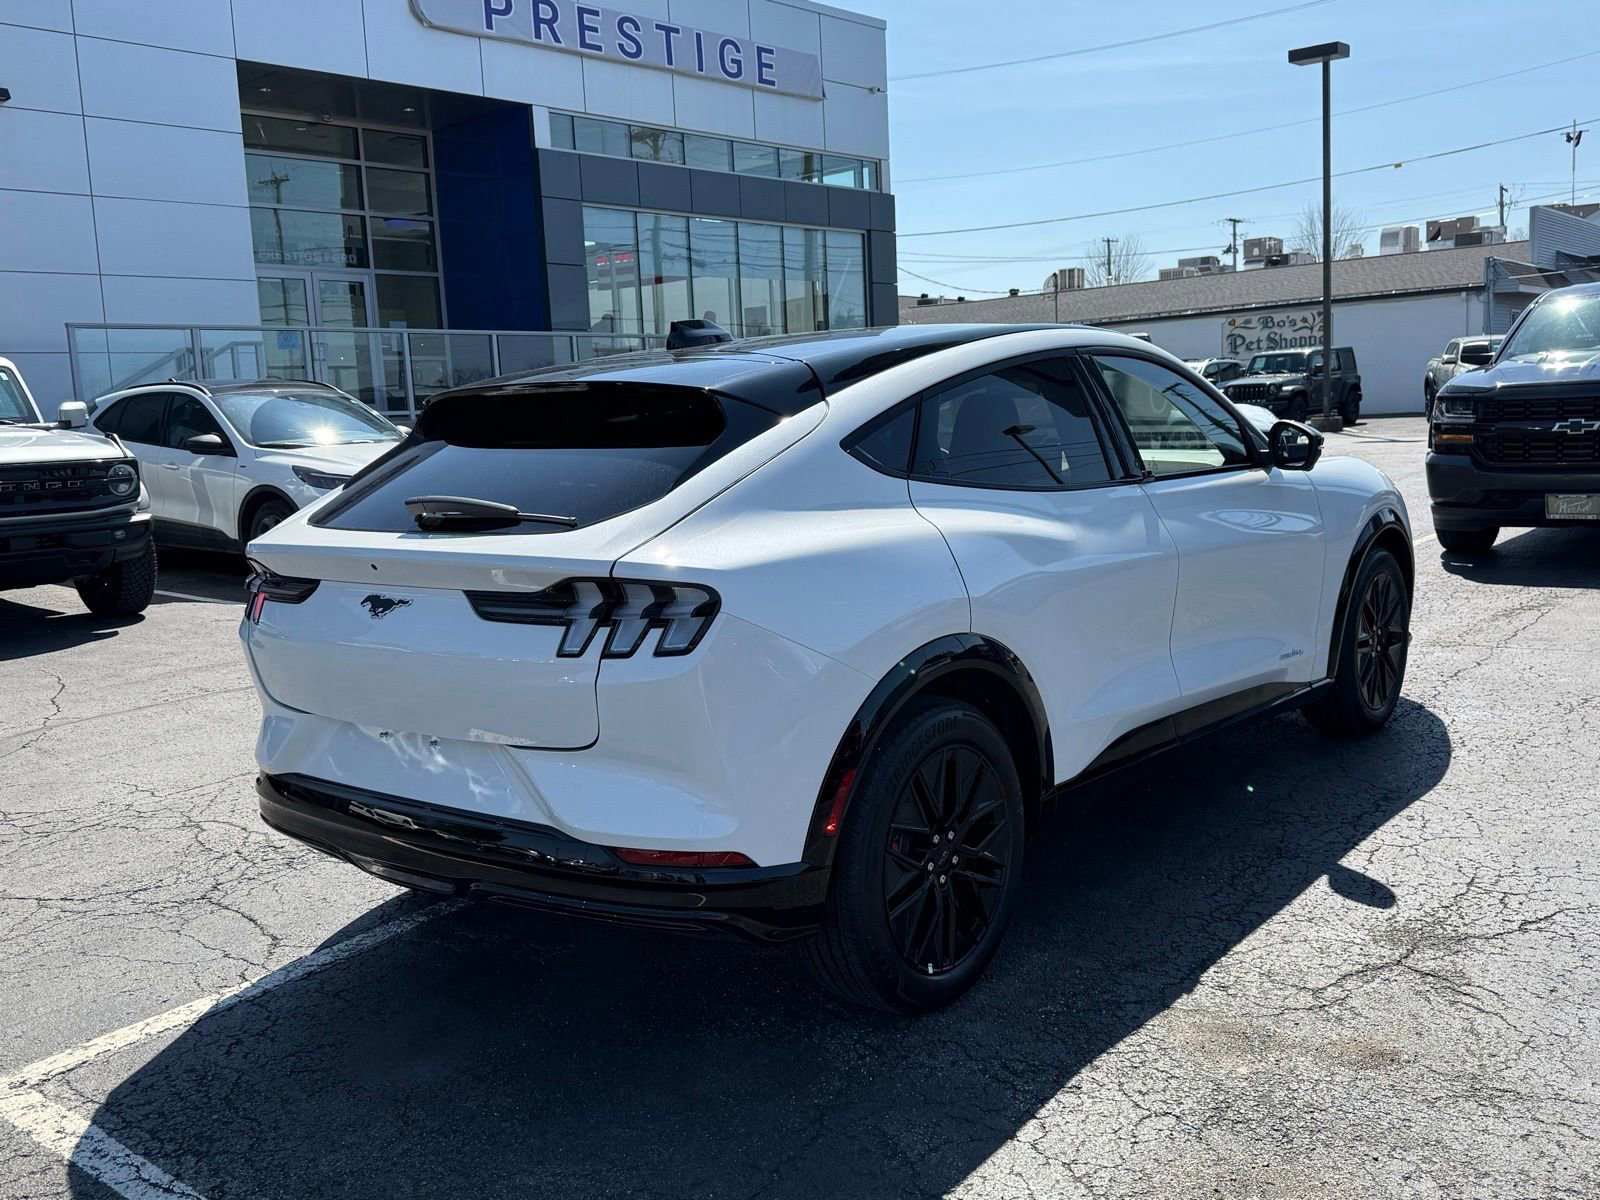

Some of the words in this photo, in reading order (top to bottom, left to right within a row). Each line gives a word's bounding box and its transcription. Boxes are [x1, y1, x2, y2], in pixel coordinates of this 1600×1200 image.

[483, 0, 778, 88] PRESTIGE
[1258, 315, 1298, 329] Bo's
[1227, 332, 1264, 355] Pet
